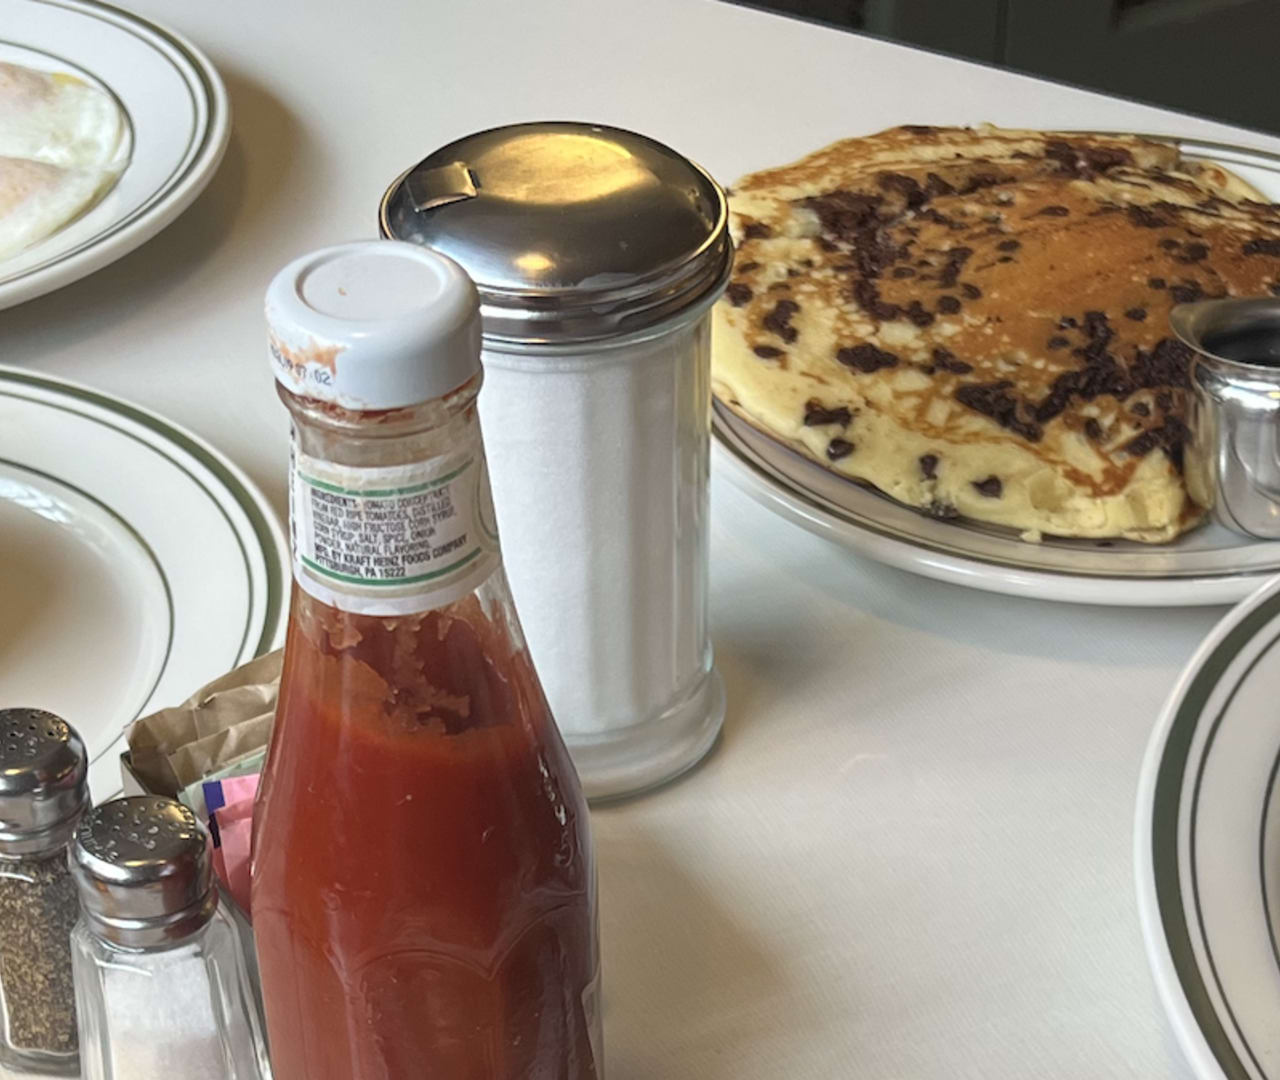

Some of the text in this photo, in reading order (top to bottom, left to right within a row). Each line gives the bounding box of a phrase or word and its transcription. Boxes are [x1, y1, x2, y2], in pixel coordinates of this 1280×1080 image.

[331, 549, 342, 561] BY
[344, 554, 370, 566] KRAFT
[373, 555, 400, 567] HEINZ
[402, 550, 431, 566] FOODS
[433, 533, 468, 559] COMPANY
[365, 566, 377, 578] PA
[380, 566, 406, 578] 15222
